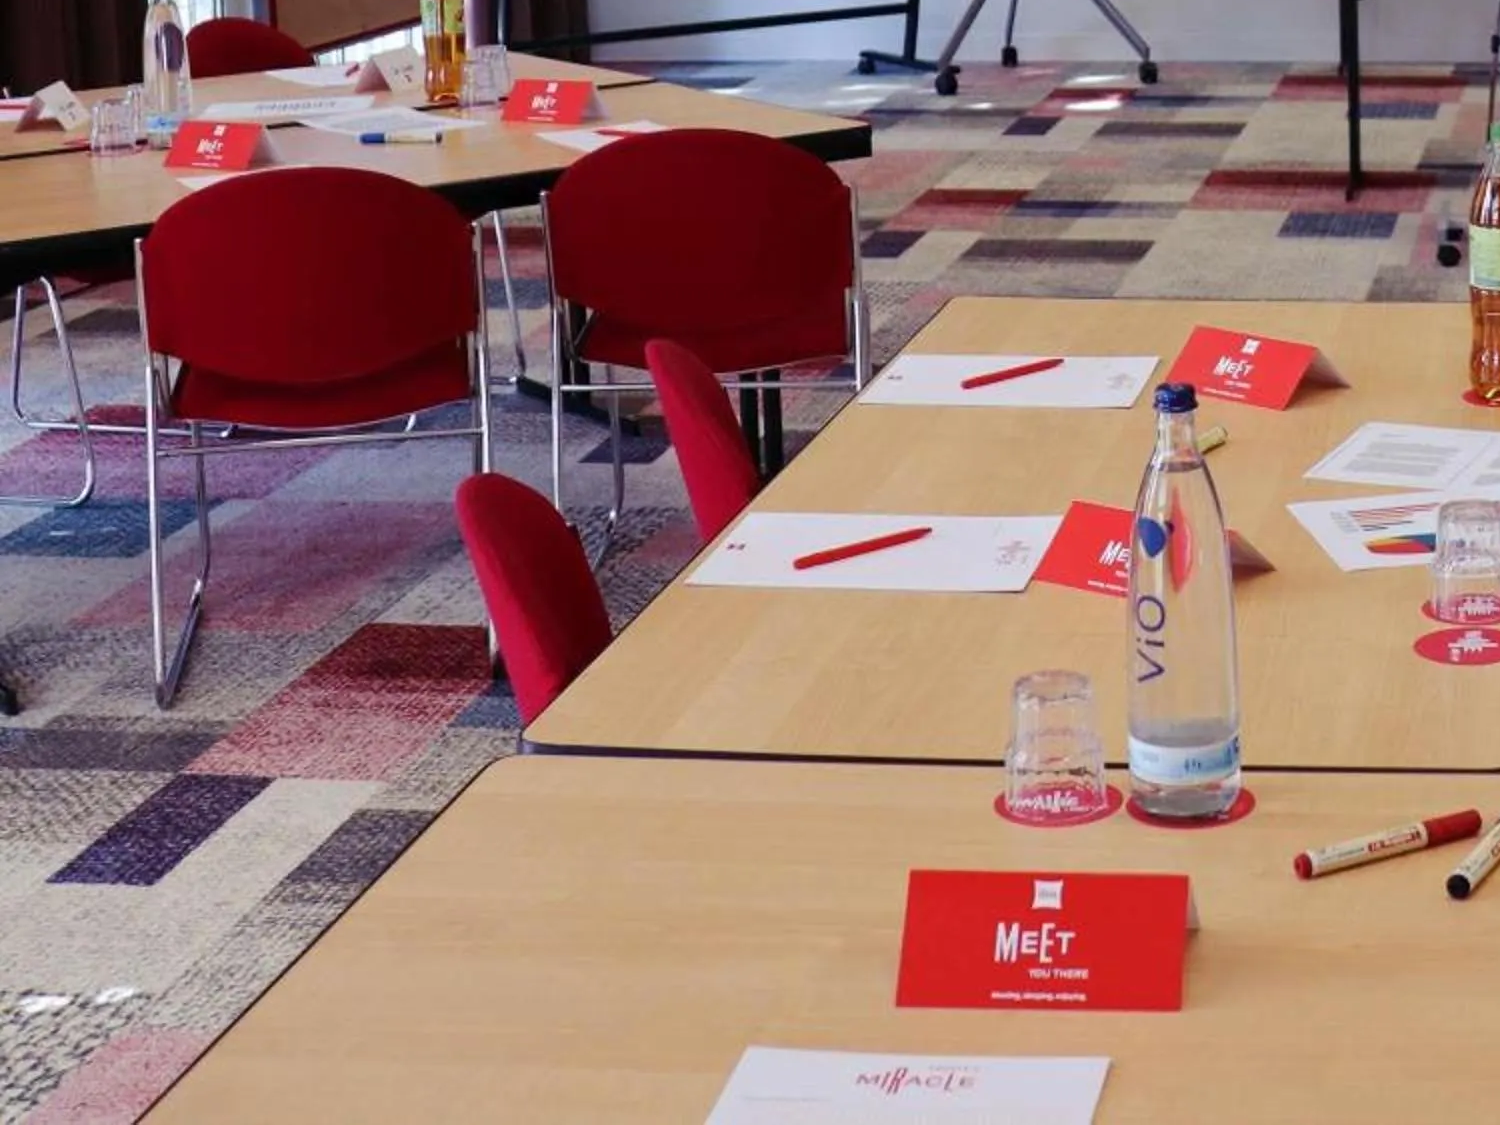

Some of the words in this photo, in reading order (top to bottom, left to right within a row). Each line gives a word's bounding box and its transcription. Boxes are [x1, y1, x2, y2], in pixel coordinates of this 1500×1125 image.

[1212, 355, 1255, 380] MEET
[994, 921, 1077, 963] MEET
[1028, 968, 1051, 979] YOU
[1052, 968, 1089, 980] THERE
